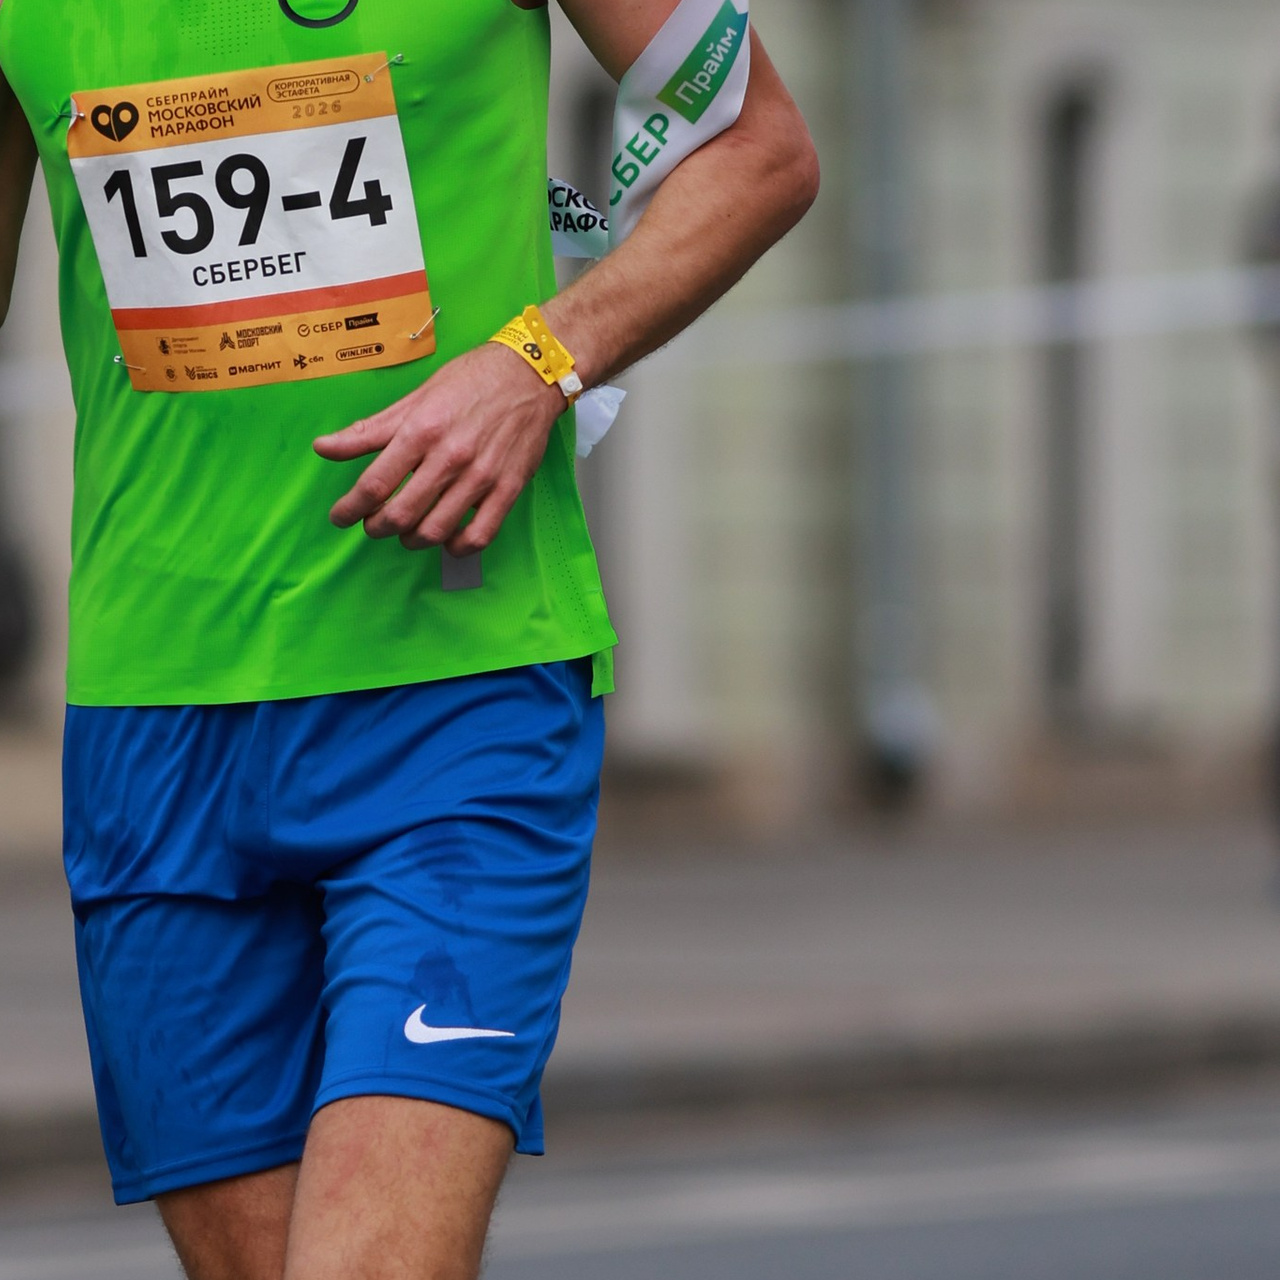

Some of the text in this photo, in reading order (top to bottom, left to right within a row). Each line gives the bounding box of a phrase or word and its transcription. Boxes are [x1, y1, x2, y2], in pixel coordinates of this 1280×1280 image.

[675, 26, 737, 105] Прайм
[274, 74, 350, 91] КОРПОРАТИВНАЯ
[146, 87, 229, 107] СБЕРПРАЙМ
[276, 86, 320, 99] ЭСТАФЕТА
[148, 94, 262, 123] МОСКОВСКИЙ
[292, 100, 342, 119] 2026
[150, 115, 234, 138] МАРАФОН
[103, 136, 393, 258] 159-4
[192, 251, 306, 287] СБЕРБЕГ
[236, 322, 283, 339] МОСКОВСКИЙ
[312, 321, 343, 333] СБЕР
[237, 337, 260, 349] СПОРТ
[339, 346, 373, 359] WINLINE
